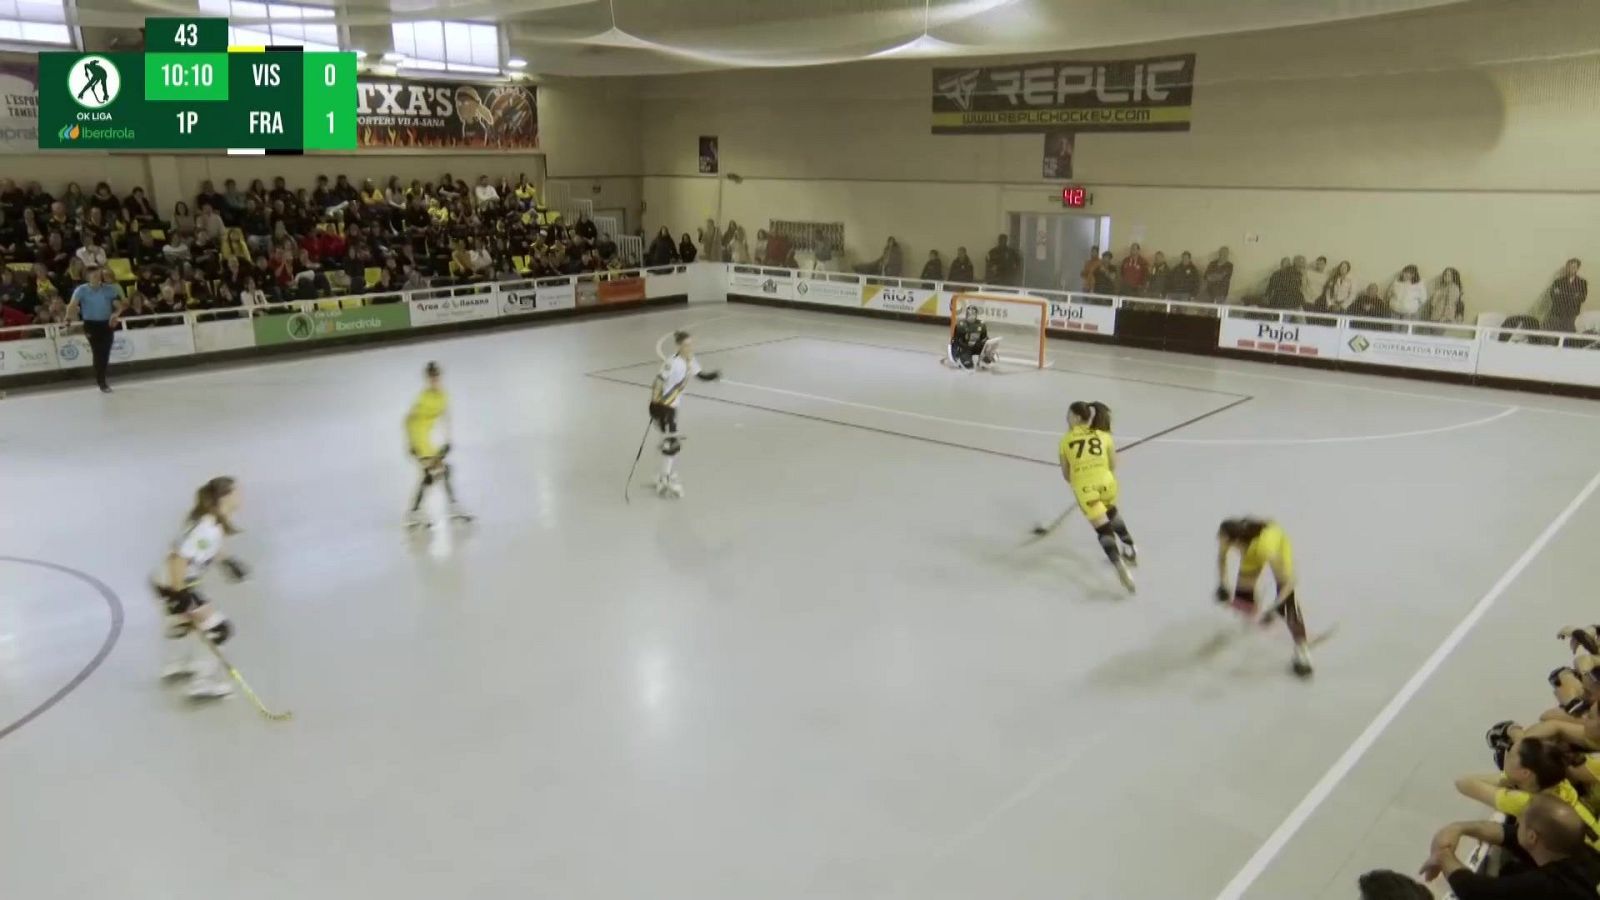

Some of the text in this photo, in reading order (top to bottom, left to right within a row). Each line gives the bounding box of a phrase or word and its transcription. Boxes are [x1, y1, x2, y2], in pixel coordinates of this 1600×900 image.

[990, 60, 1186, 105] REPLIC
[1064, 189, 1083, 205] 42
[1050, 303, 1083, 321] Pujol
[335, 317, 382, 331] Iberdrola
[1257, 323, 1300, 343] Pujol
[1068, 437, 1103, 459] 78
